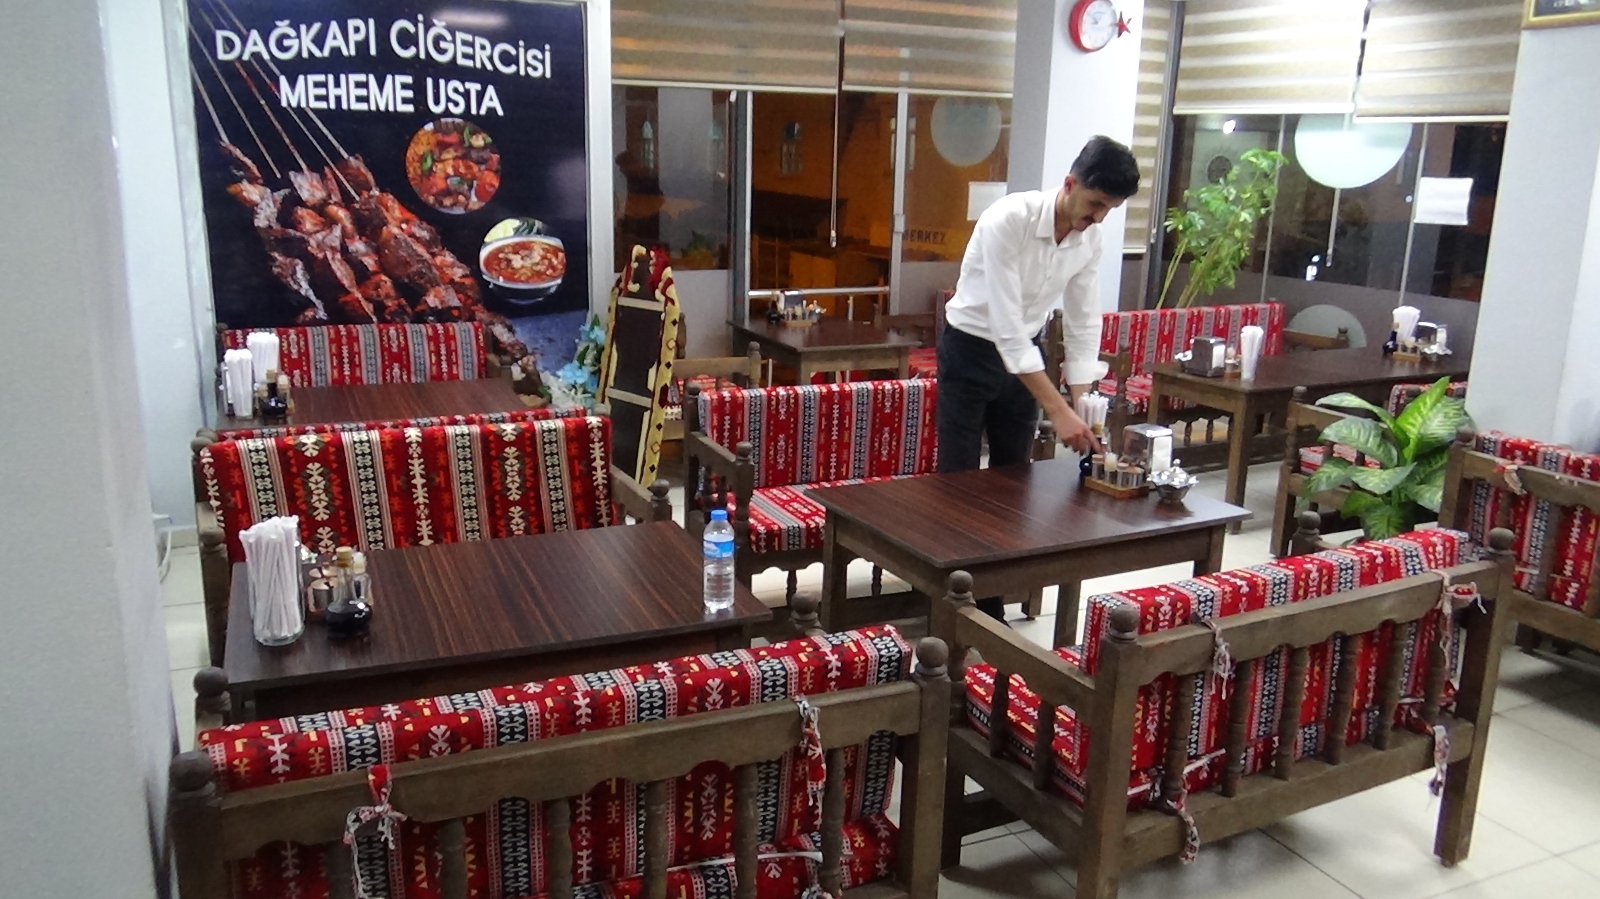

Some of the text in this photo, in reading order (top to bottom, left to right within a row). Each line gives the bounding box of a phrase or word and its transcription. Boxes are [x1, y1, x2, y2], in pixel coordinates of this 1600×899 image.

[215, 14, 552, 79] DAĞKAPI CİĞERCİSİ
[278, 73, 504, 117] MEHEME USTA
